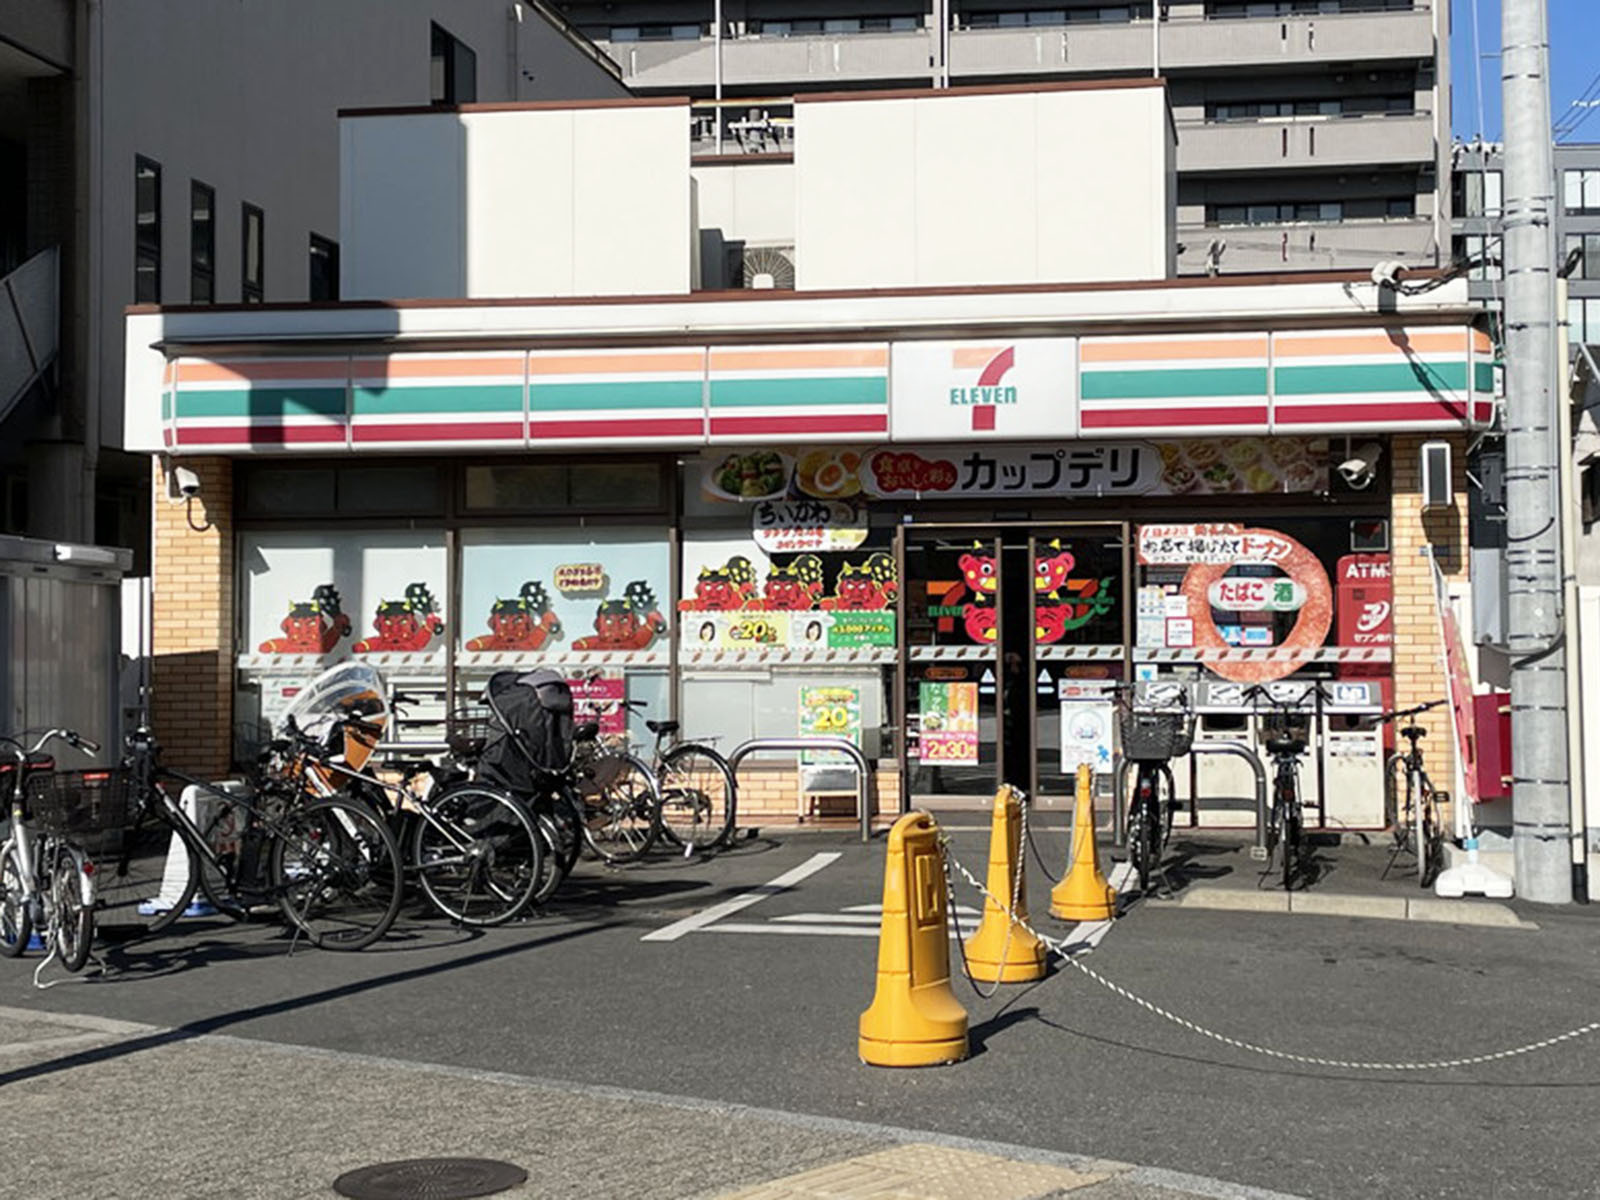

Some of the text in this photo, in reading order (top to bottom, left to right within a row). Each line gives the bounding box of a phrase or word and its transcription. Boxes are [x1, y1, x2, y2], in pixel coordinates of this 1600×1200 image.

[953, 346, 1014, 430] 7
[962, 449, 1140, 490] カップデリ
[758, 500, 831, 525] ちいかわ
[1220, 582, 1265, 602] たばこ
[1273, 582, 1294, 602] 酒
[814, 706, 848, 729] 20
